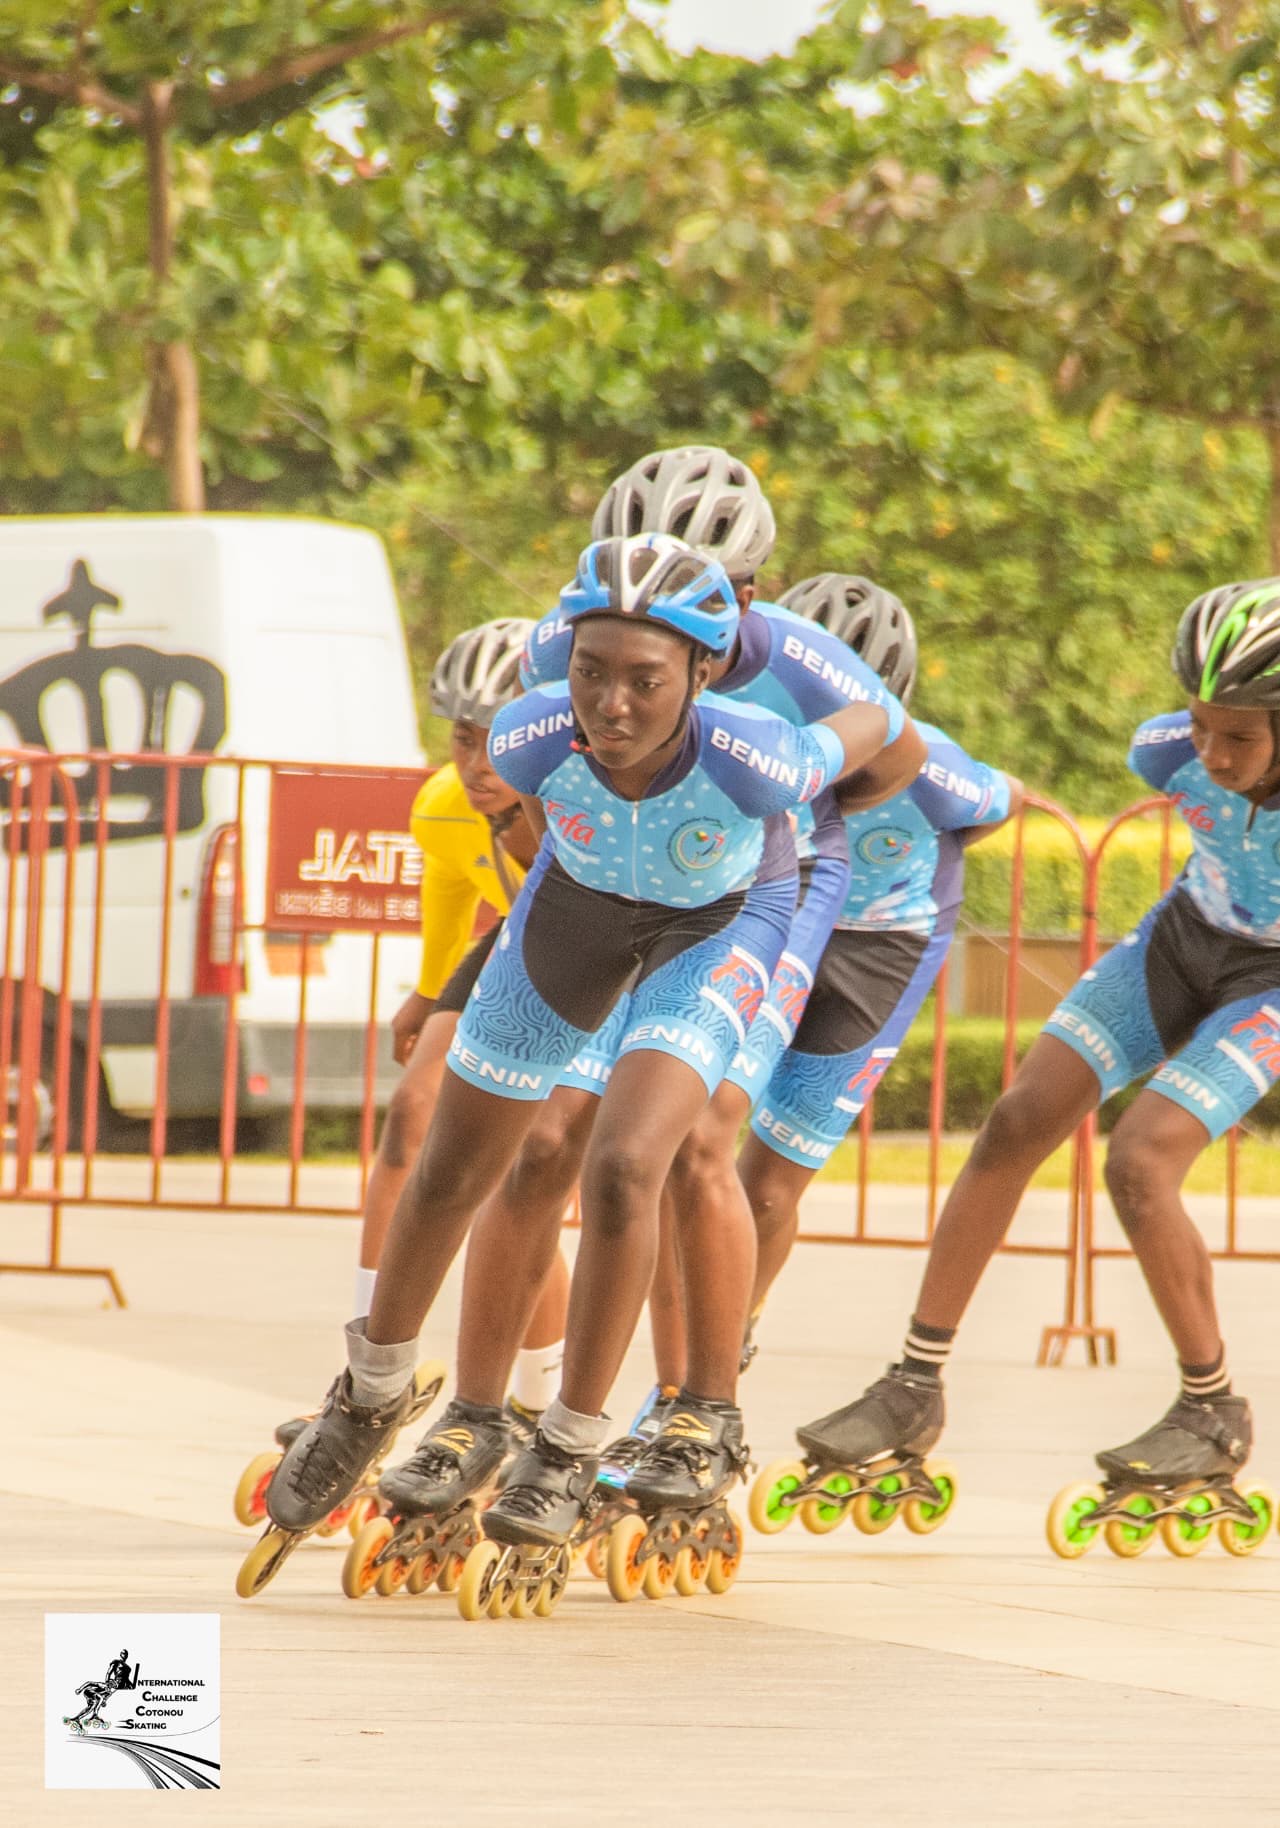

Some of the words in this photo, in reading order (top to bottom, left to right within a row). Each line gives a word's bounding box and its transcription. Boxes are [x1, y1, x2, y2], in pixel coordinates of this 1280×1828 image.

[782, 634, 870, 703] BENIN
[492, 710, 575, 757] BENIN
[710, 726, 799, 787] BENIN
